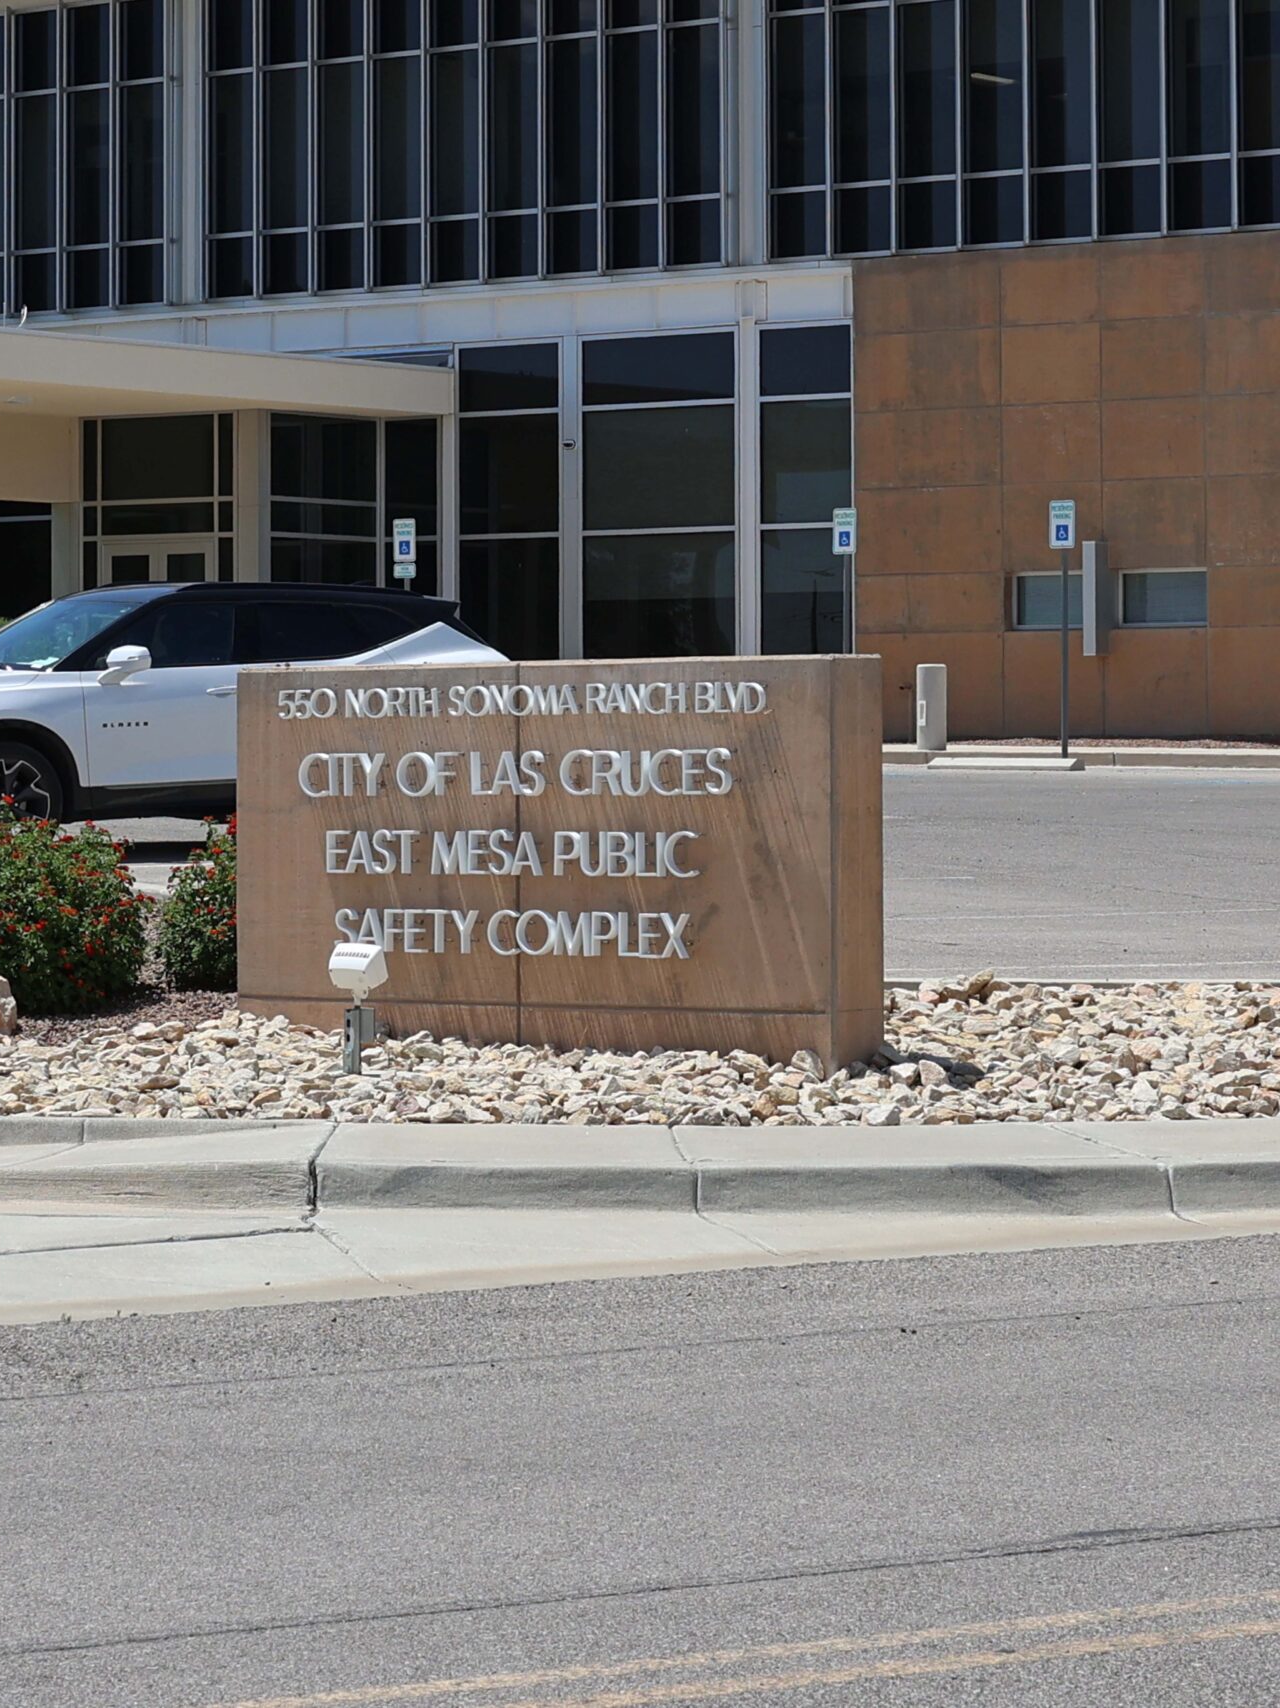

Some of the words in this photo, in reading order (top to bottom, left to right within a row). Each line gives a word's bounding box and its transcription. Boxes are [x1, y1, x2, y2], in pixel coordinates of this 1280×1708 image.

[278, 688, 337, 719] 550
[344, 687, 439, 718] NORTH
[448, 684, 579, 717] SONOMA
[585, 682, 686, 715] RANCH
[695, 682, 767, 714] BLVD
[298, 753, 386, 798] CITY
[396, 752, 465, 797] OF
[470, 751, 546, 797] LAS
[559, 748, 732, 797] CRUCES
[325, 829, 419, 875] EAST
[431, 829, 543, 876] MESA
[553, 831, 700, 878] PUBLIC
[334, 908, 479, 954] SAFETY
[487, 909, 690, 959] COMPLEX
